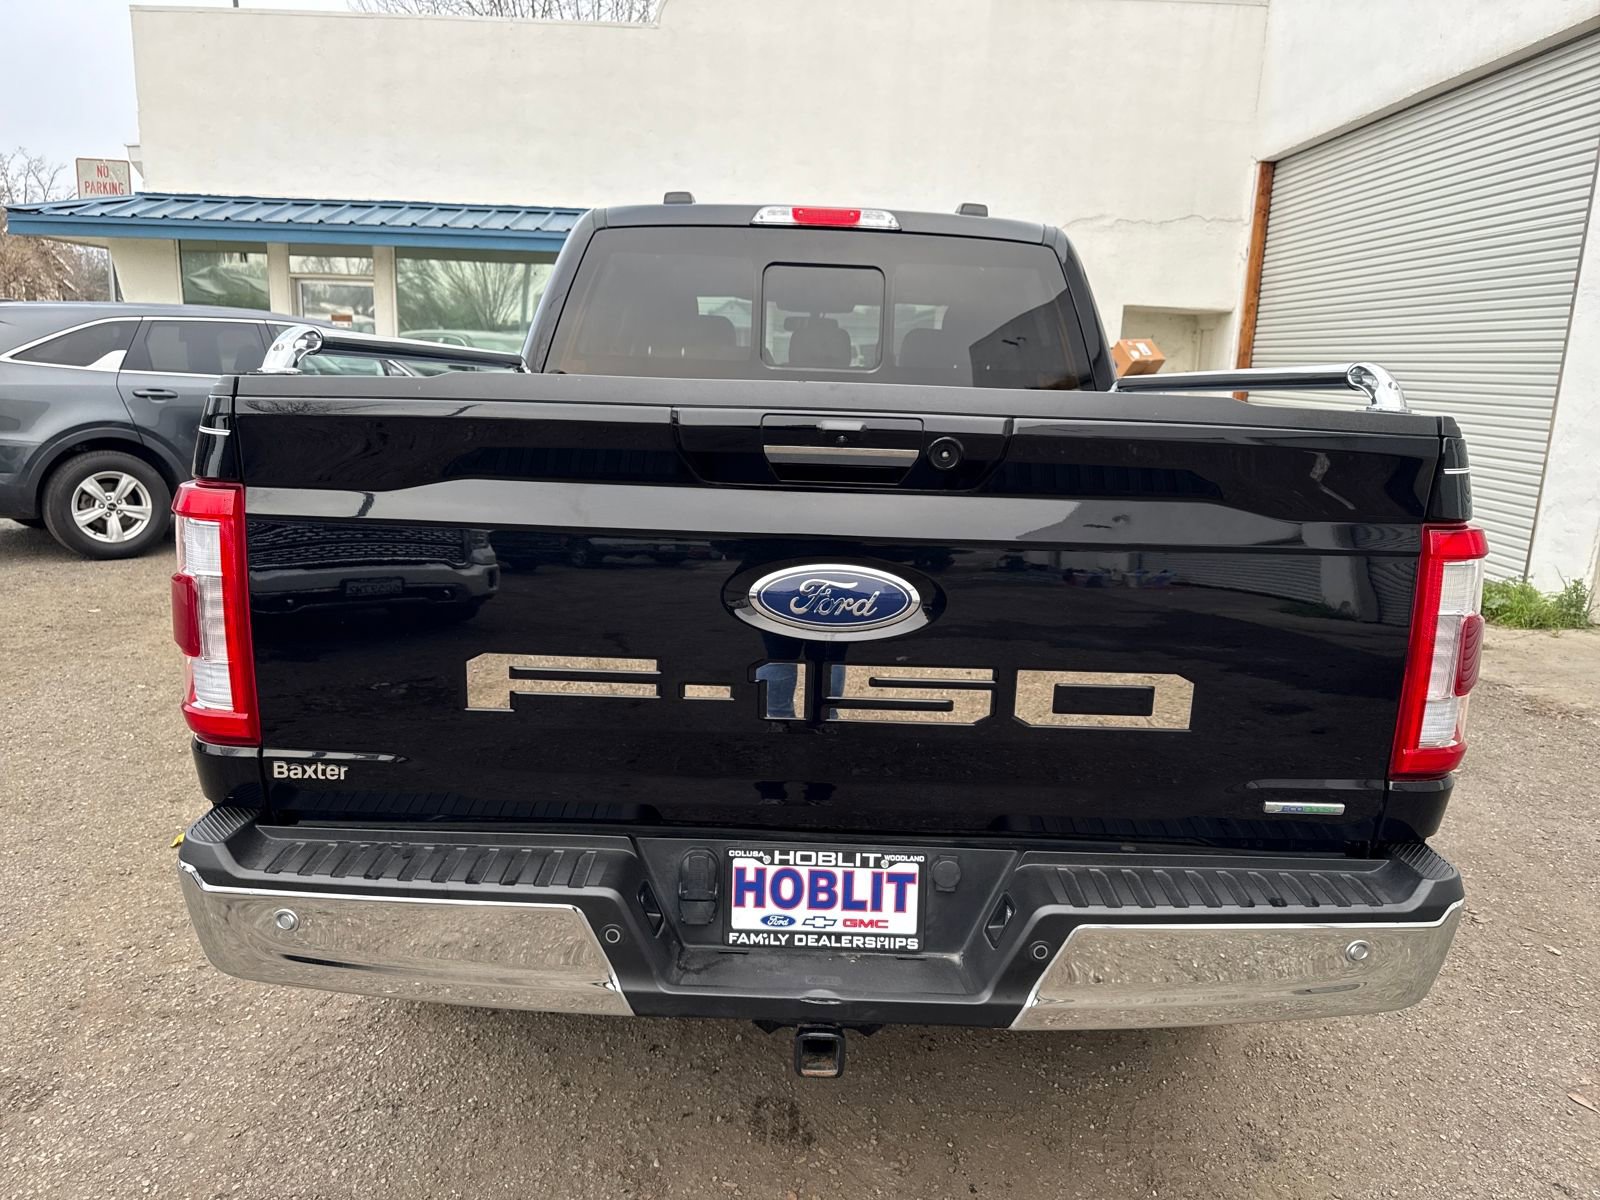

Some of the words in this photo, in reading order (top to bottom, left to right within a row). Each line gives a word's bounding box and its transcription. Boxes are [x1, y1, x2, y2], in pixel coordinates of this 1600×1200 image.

[96, 165, 109, 178] NO
[84, 181, 124, 195] PARKING
[789, 578, 880, 617] Ford
[465, 652, 1195, 732] F-150
[273, 761, 349, 780] Baxter
[728, 850, 765, 858] COLUSA
[774, 850, 882, 868] HOBLIT
[884, 854, 925, 863] WOODLAND
[733, 867, 917, 913] HOBLIT
[842, 918, 889, 929] GMC
[794, 934, 919, 950] DEALERSHIPS
